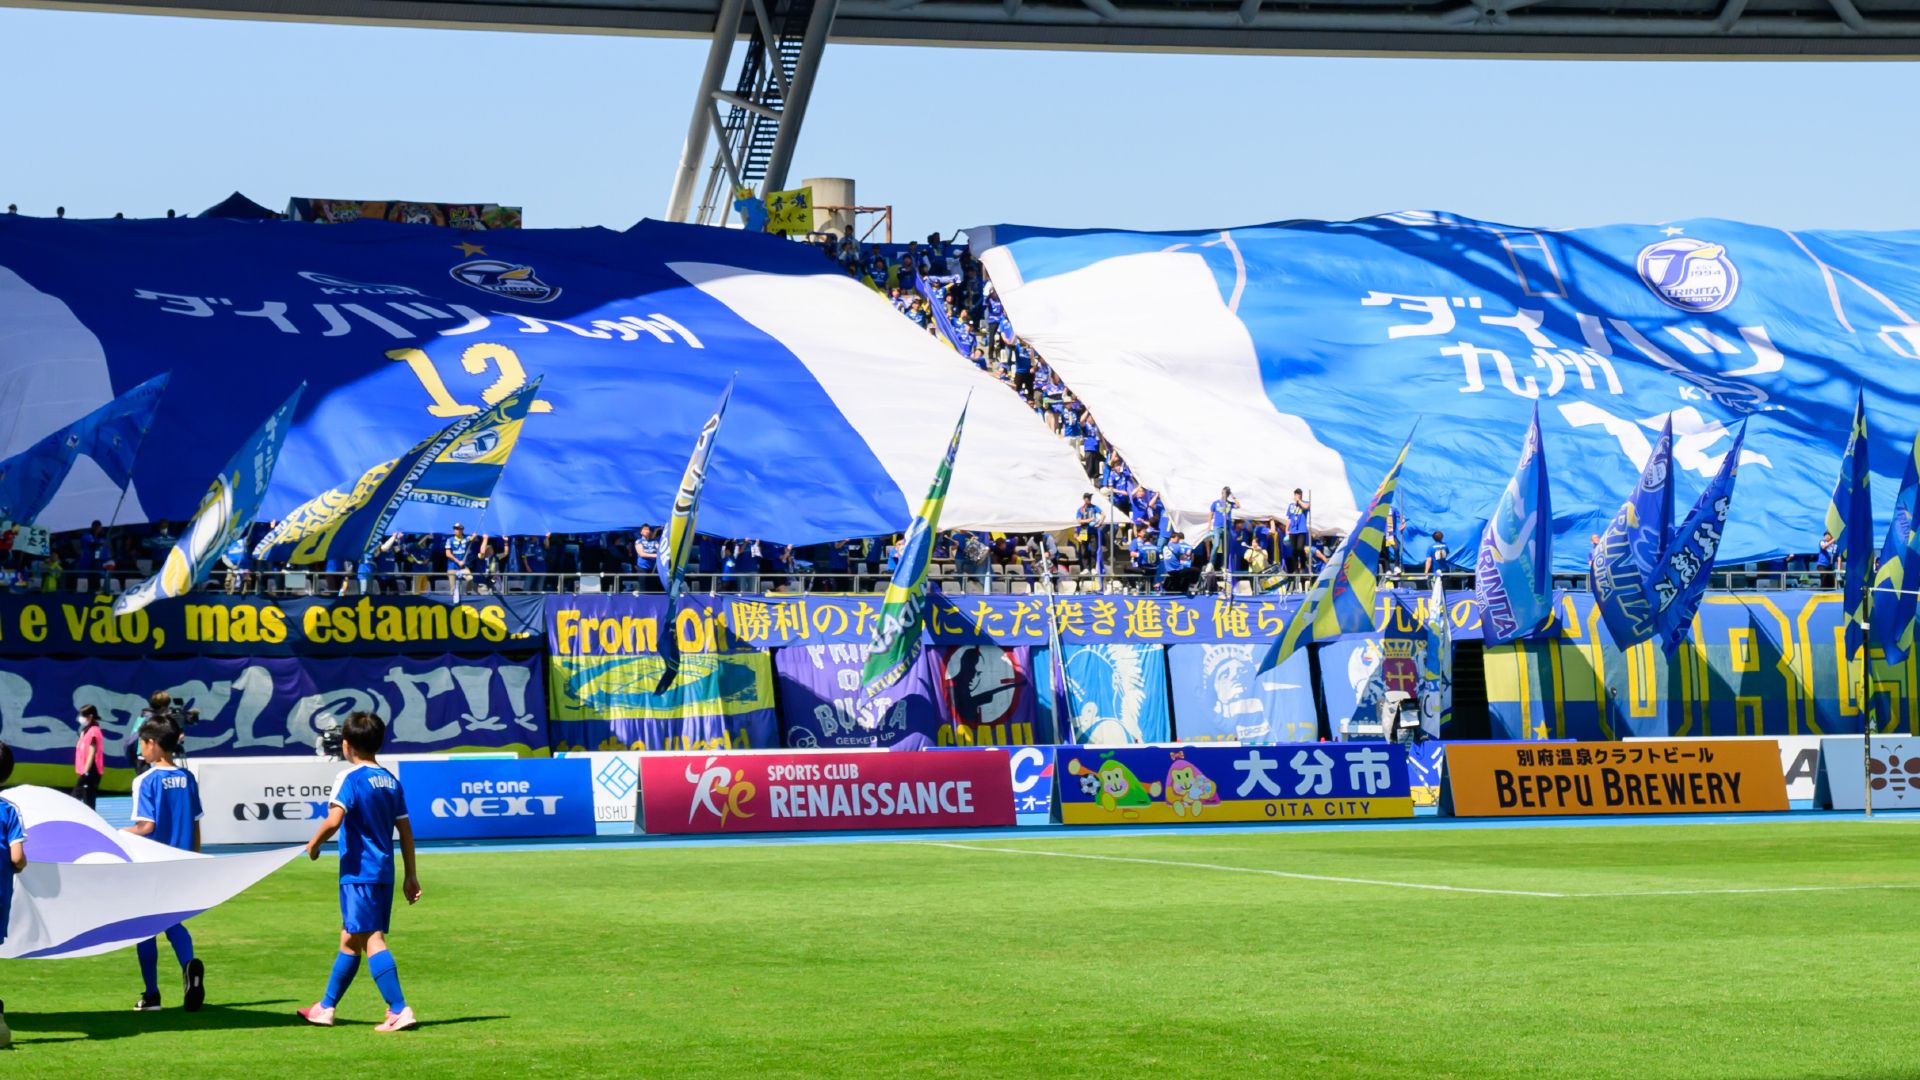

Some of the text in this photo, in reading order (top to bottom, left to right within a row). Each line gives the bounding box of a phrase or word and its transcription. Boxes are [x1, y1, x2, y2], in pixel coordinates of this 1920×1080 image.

[1666, 287, 1720, 297] TRINITA
[1361, 291, 1784, 377] ダイハツ
[385, 342, 553, 418] 12
[1440, 341, 1623, 398] 九州
[19, 604, 48, 642] e
[185, 603, 288, 644] mas
[303, 595, 530, 643] estamos...
[556, 609, 658, 654] From
[731, 598, 1200, 641] 勝利のたにただ突き進む
[1212, 598, 1287, 638] 俺ら
[813, 696, 908, 737] BUSTA
[836, 732, 895, 746] GEEKED UP
[1516, 747, 1714, 767] 別府温泉クラフトビール
[767, 763, 858, 781] SPORTS CLUB
[1233, 747, 1391, 798] 大分市
[1785, 748, 1819, 785] A
[264, 785, 332, 798] net one
[461, 780, 530, 794] net one
[769, 780, 974, 818] RENAISSANCE
[1494, 767, 1741, 808] BEPPU BREWERY
[233, 802, 329, 821] NEX
[431, 795, 563, 818] NEXT
[597, 805, 628, 819] USHU
[1264, 801, 1370, 817] OITA CITY
